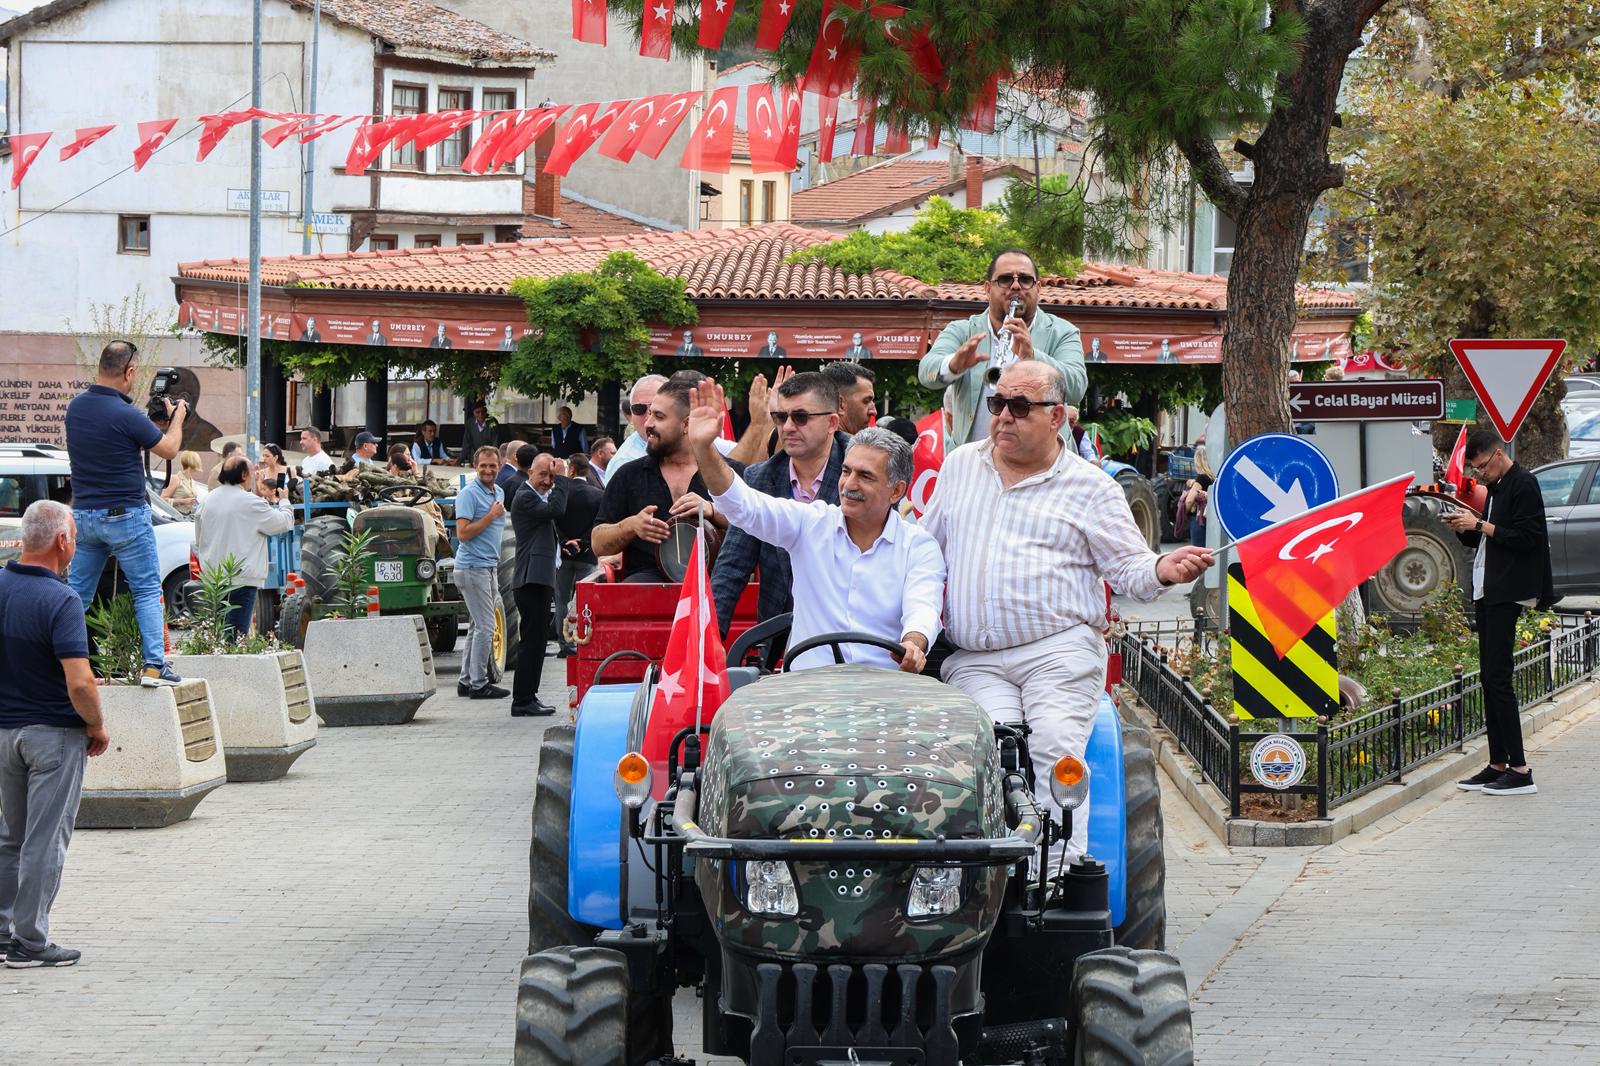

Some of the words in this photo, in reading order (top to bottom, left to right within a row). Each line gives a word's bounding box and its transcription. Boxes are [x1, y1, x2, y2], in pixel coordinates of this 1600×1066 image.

[390, 323, 426, 331] UMURBEY
[38, 381, 62, 389] DAHA
[1314, 394, 1348, 407] Celal
[1350, 393, 1389, 409] Bayar
[1391, 391, 1437, 405] Müzesi
[14, 402, 50, 411] MEYDAN
[26, 424, 61, 435] YÜKSELİŞ
[376, 562, 386, 571] 16
[390, 562, 401, 572] NR
[384, 571, 401, 580] 630
